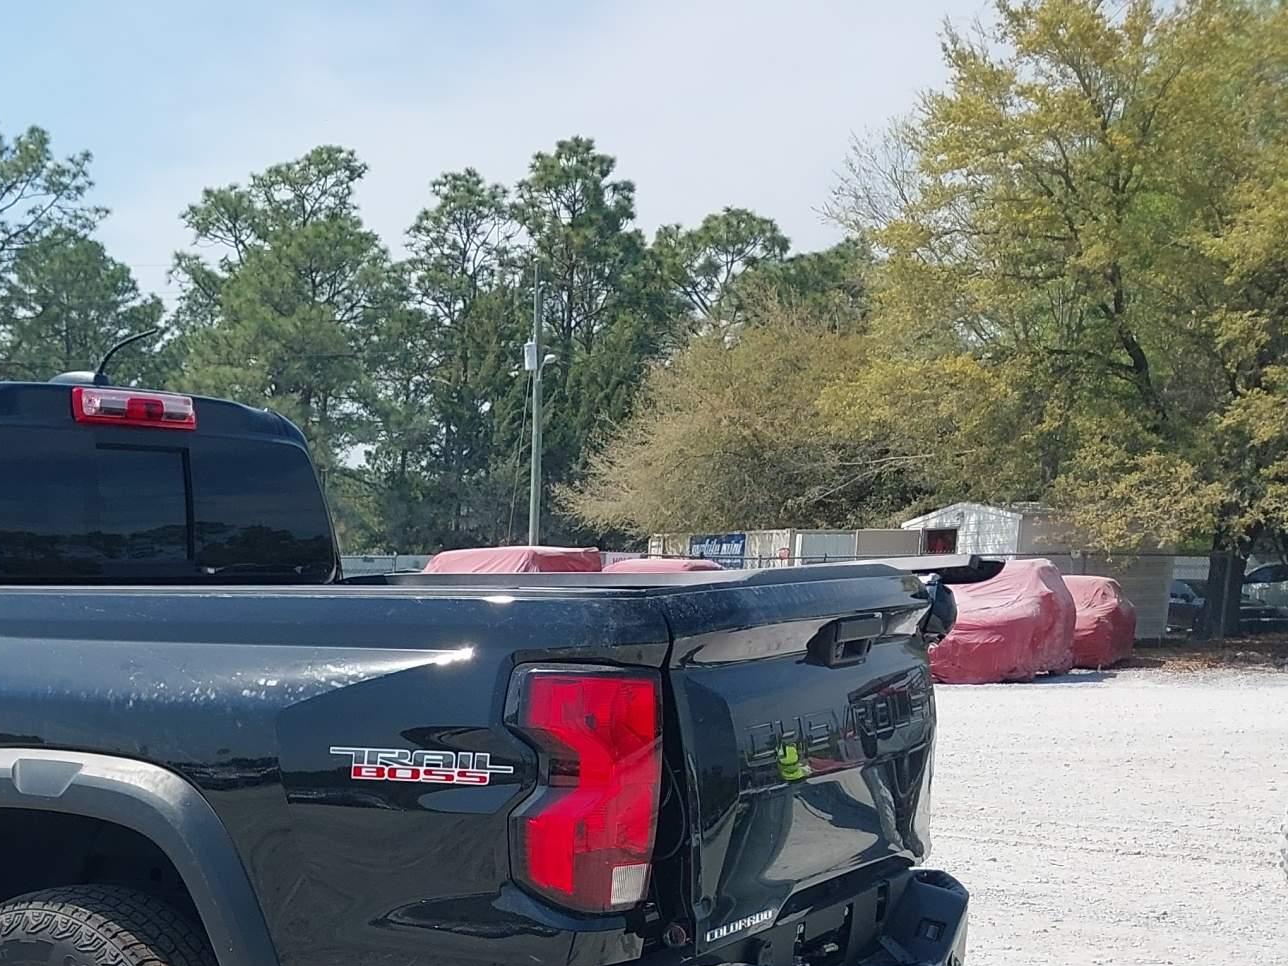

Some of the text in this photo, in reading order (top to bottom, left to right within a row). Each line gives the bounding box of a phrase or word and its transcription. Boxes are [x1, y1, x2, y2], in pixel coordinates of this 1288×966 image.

[330, 746, 514, 773] TRAIL
[351, 765, 490, 785] BOSS
[706, 909, 773, 942] COLORADO
